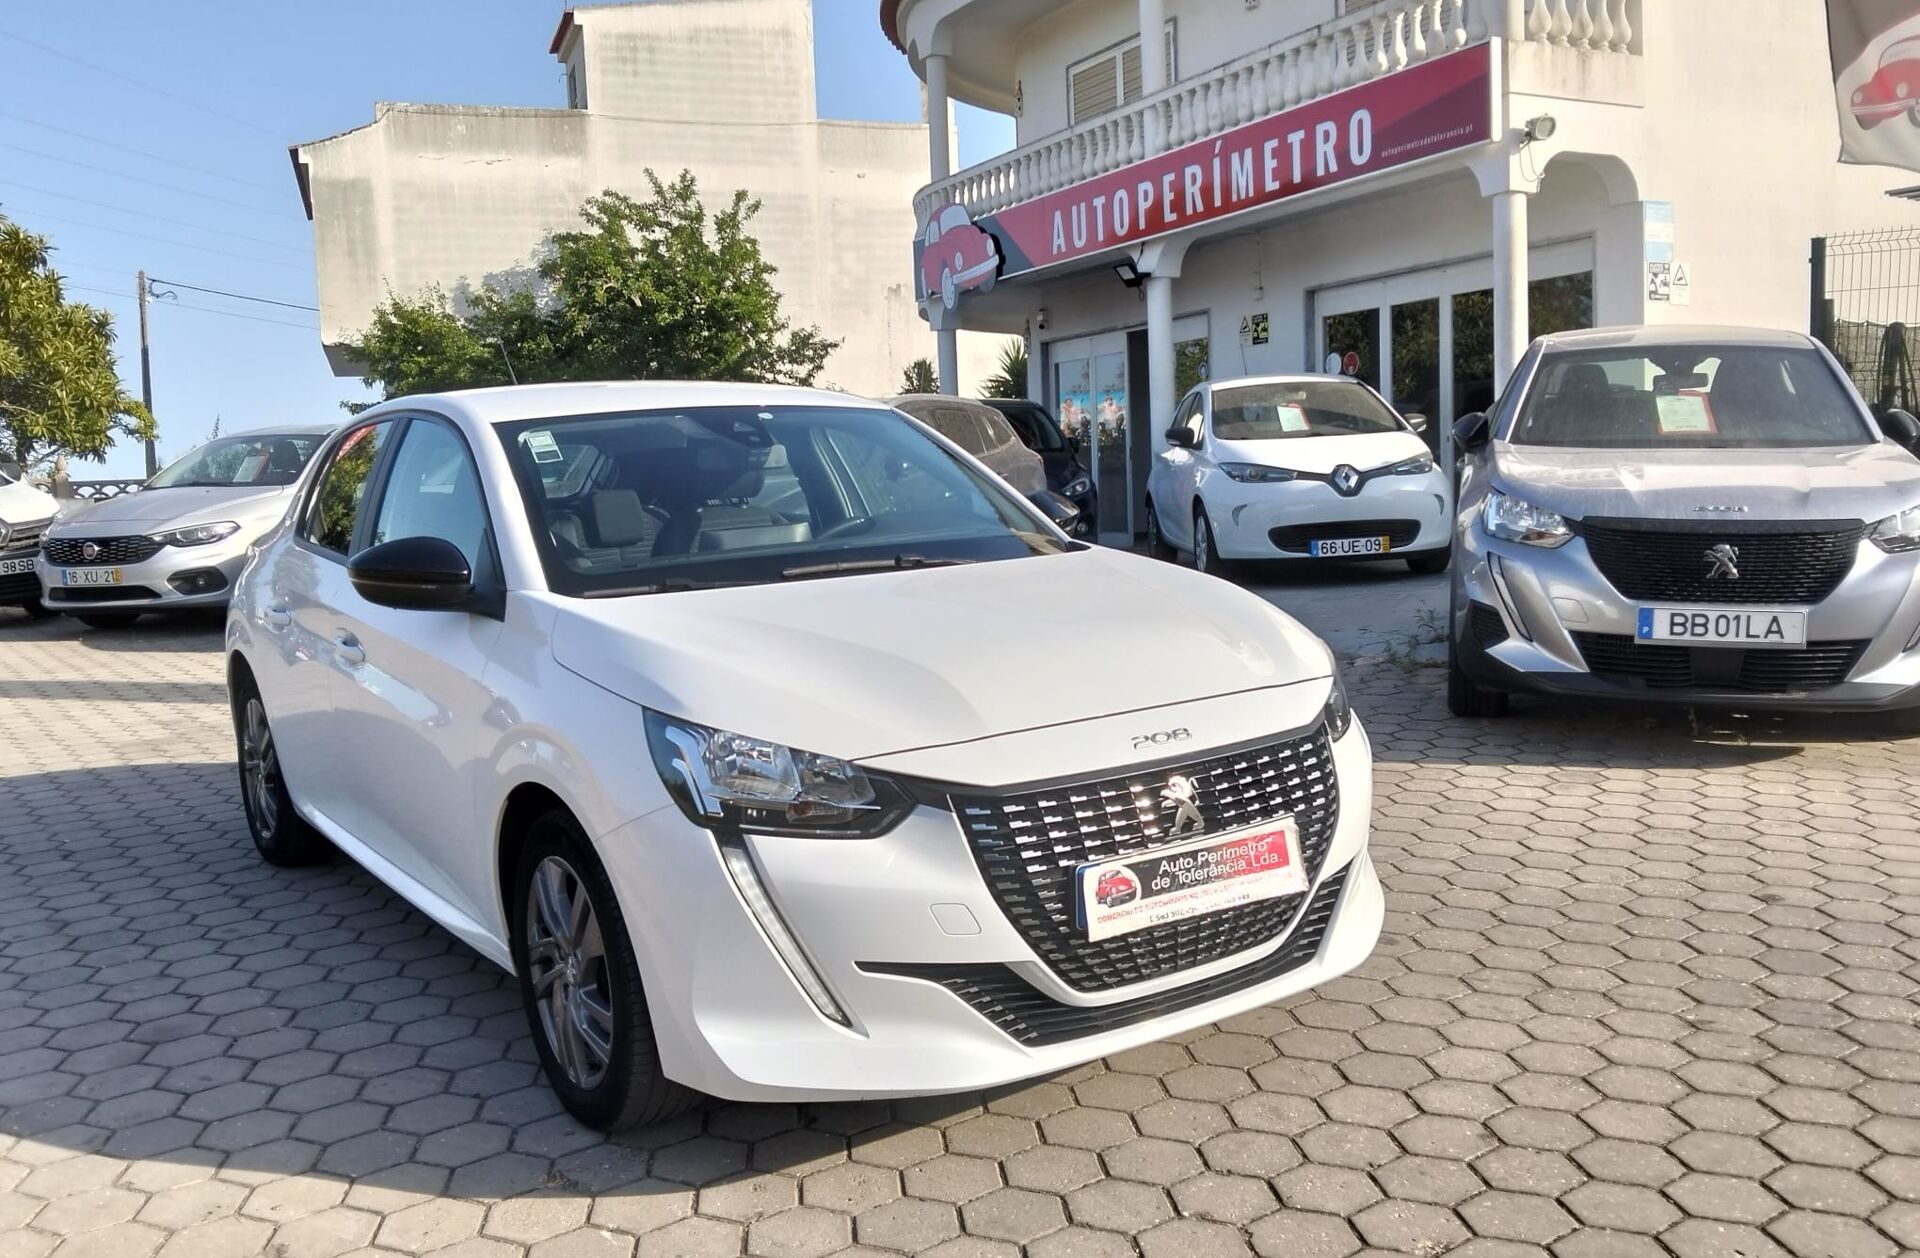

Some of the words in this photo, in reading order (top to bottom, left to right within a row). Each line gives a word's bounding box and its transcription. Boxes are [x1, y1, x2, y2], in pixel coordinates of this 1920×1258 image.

[1052, 108, 1372, 255] AUTOPERÍMETRO
[1131, 727, 1193, 750] 208
[1151, 875, 1171, 891] de
[1175, 859, 1247, 885] Tolerância
[1251, 851, 1283, 868] Lda.
[1159, 857, 1193, 875] Auto
[1197, 841, 1268, 865] Perímetro
